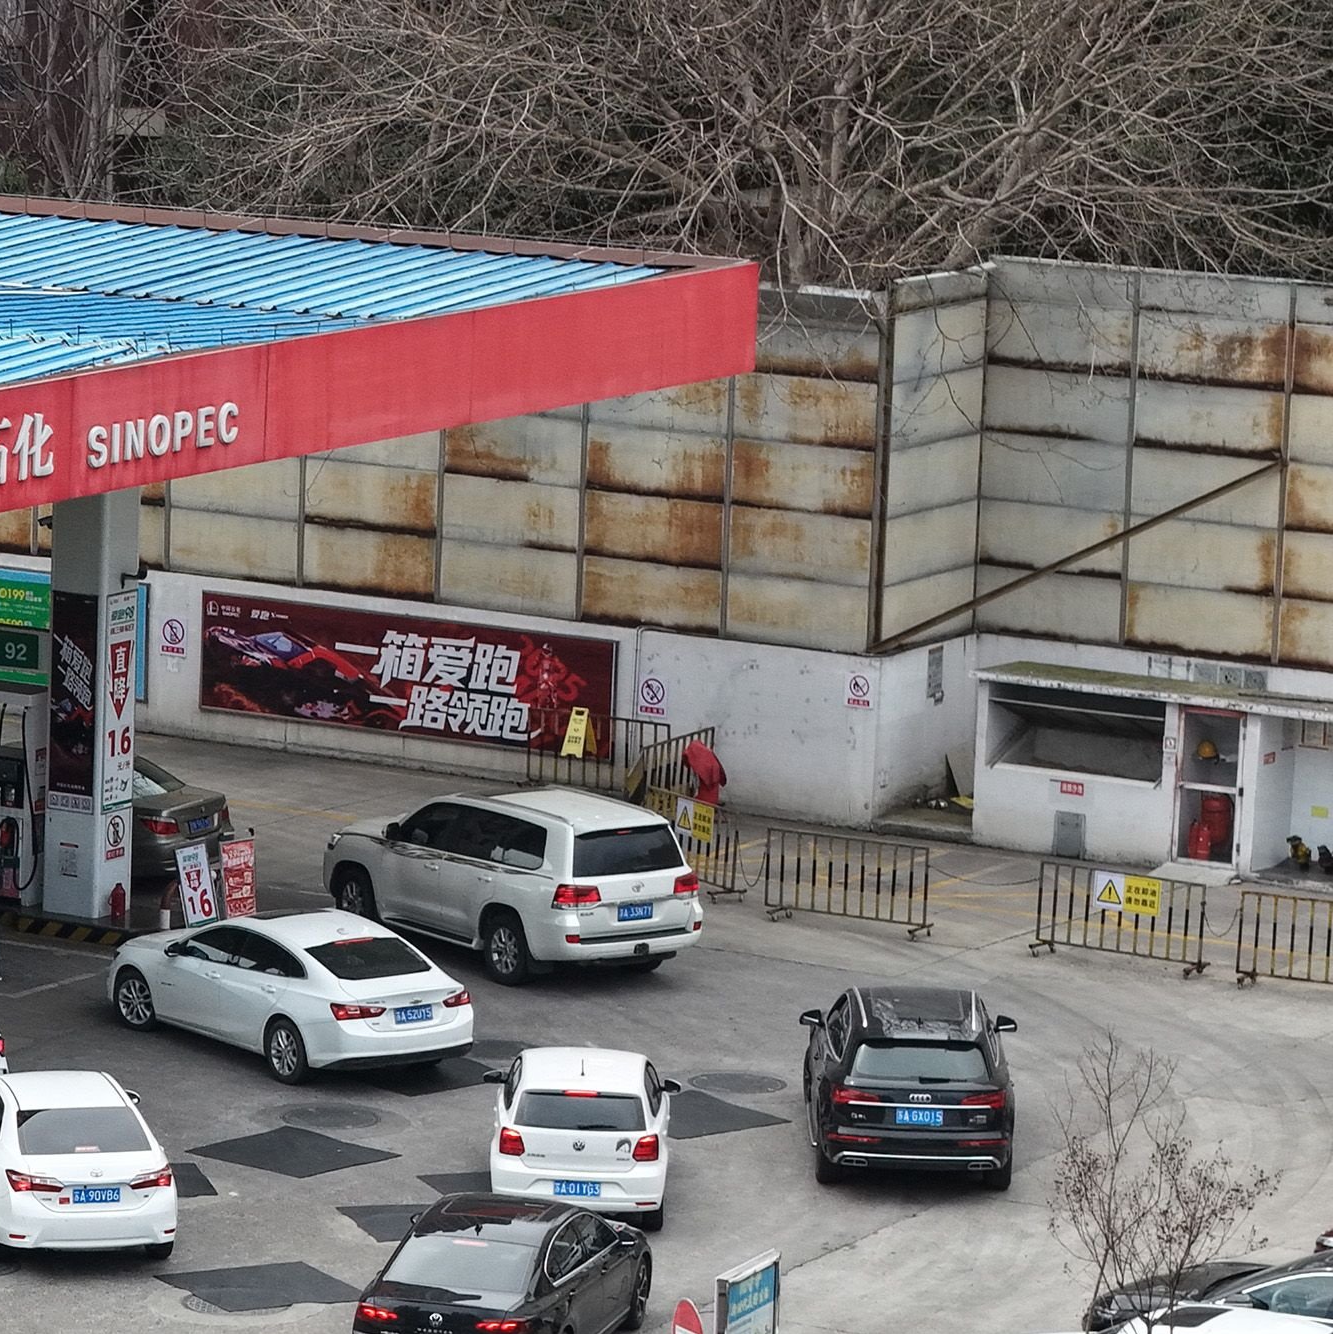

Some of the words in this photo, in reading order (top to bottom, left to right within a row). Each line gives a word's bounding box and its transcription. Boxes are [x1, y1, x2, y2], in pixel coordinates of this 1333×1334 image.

[88, 402, 239, 469] SINOPEC
[5, 642, 28, 661] 92
[115, 647, 127, 704] 直降
[335, 630, 521, 695] 一箱爱跑
[369, 686, 541, 741] 一路领跑
[108, 726, 132, 757] 1.6
[188, 888, 213, 918] 1.6
